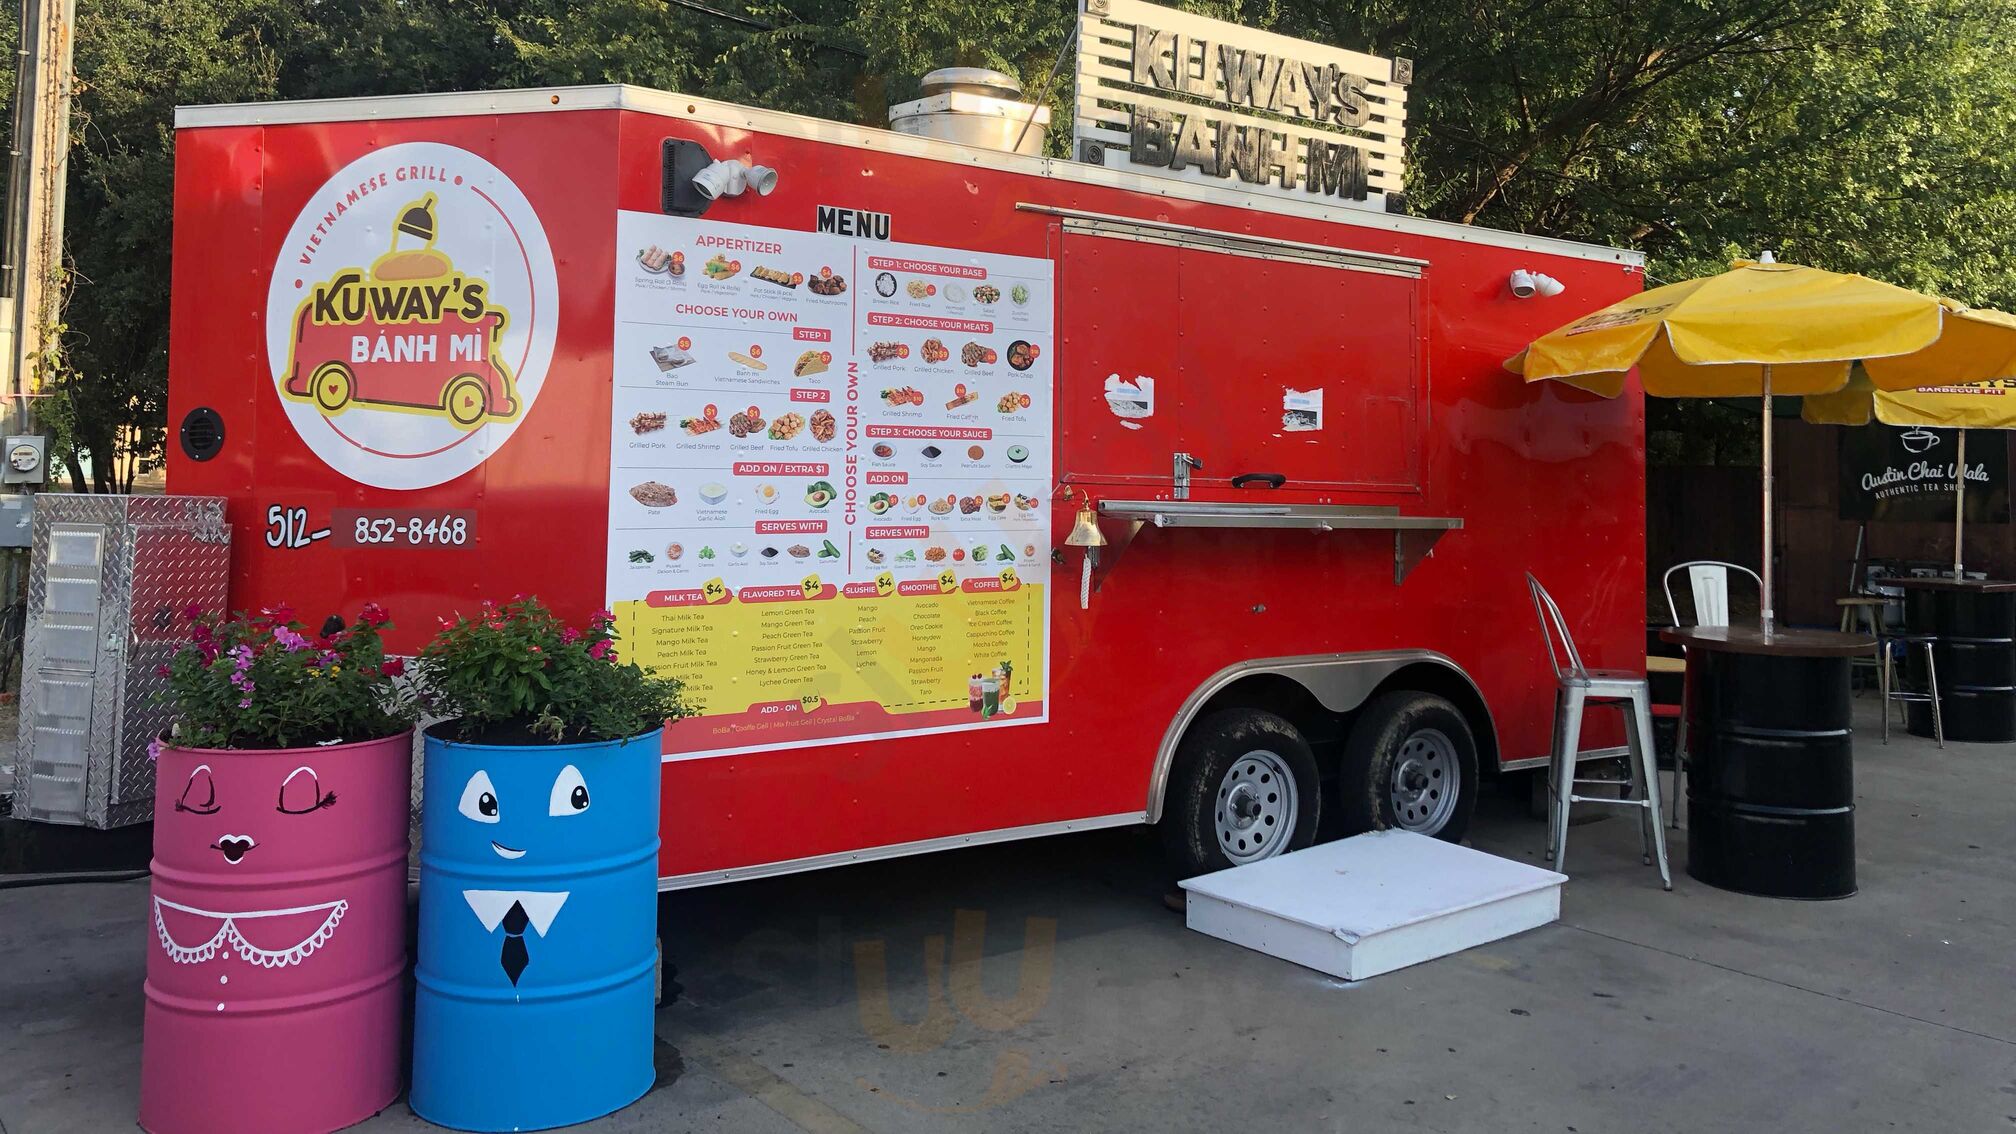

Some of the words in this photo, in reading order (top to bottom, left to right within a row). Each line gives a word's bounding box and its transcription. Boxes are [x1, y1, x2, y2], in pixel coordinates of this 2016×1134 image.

[1130, 104, 1297, 189] BANH
[1306, 138, 1368, 201] MI
[300, 172, 387, 264] VIETNAMESE
[396, 166, 447, 182] GRILL
[818, 206, 889, 240] MENU
[696, 235, 782, 255] APPERTIZER
[873, 259, 894, 267] STEP
[903, 262, 937, 272] CHOOSE
[939, 266, 961, 274] YOUR
[963, 268, 983, 276] BASE
[315, 274, 484, 322] KUWAY'S
[676, 304, 728, 316] CHOOSE
[732, 308, 764, 320] YOUR
[768, 311, 797, 322] OWN
[904, 318, 938, 327] CHOOSE
[940, 321, 961, 329] YOUR
[799, 330, 821, 339] STEP
[351, 330, 436, 363] BÁNH
[450, 328, 481, 362] MÌ
[714, 376, 747, 384] Vietnamese
[847, 362, 858, 401] OWN
[846, 405, 858, 451] YOUR
[816, 465, 824, 474] $1
[1861, 466, 1907, 490] Austin
[1908, 461, 1944, 480] Chai
[845, 454, 857, 525] CHOOSE
[1875, 485, 1919, 500] AUTHENTIC
[266, 505, 331, 548] 512-
[355, 515, 466, 544] 852-8468
[805, 580, 819, 592] $4
[879, 577, 892, 588] $4
[941, 576, 954, 586] $4
[1002, 573, 1014, 583] $4
[706, 584, 722, 595] $4
[901, 584, 937, 592] SMOOTHIE
[652, 627, 685, 635] Signature
[754, 656, 788, 664] Strawberry
